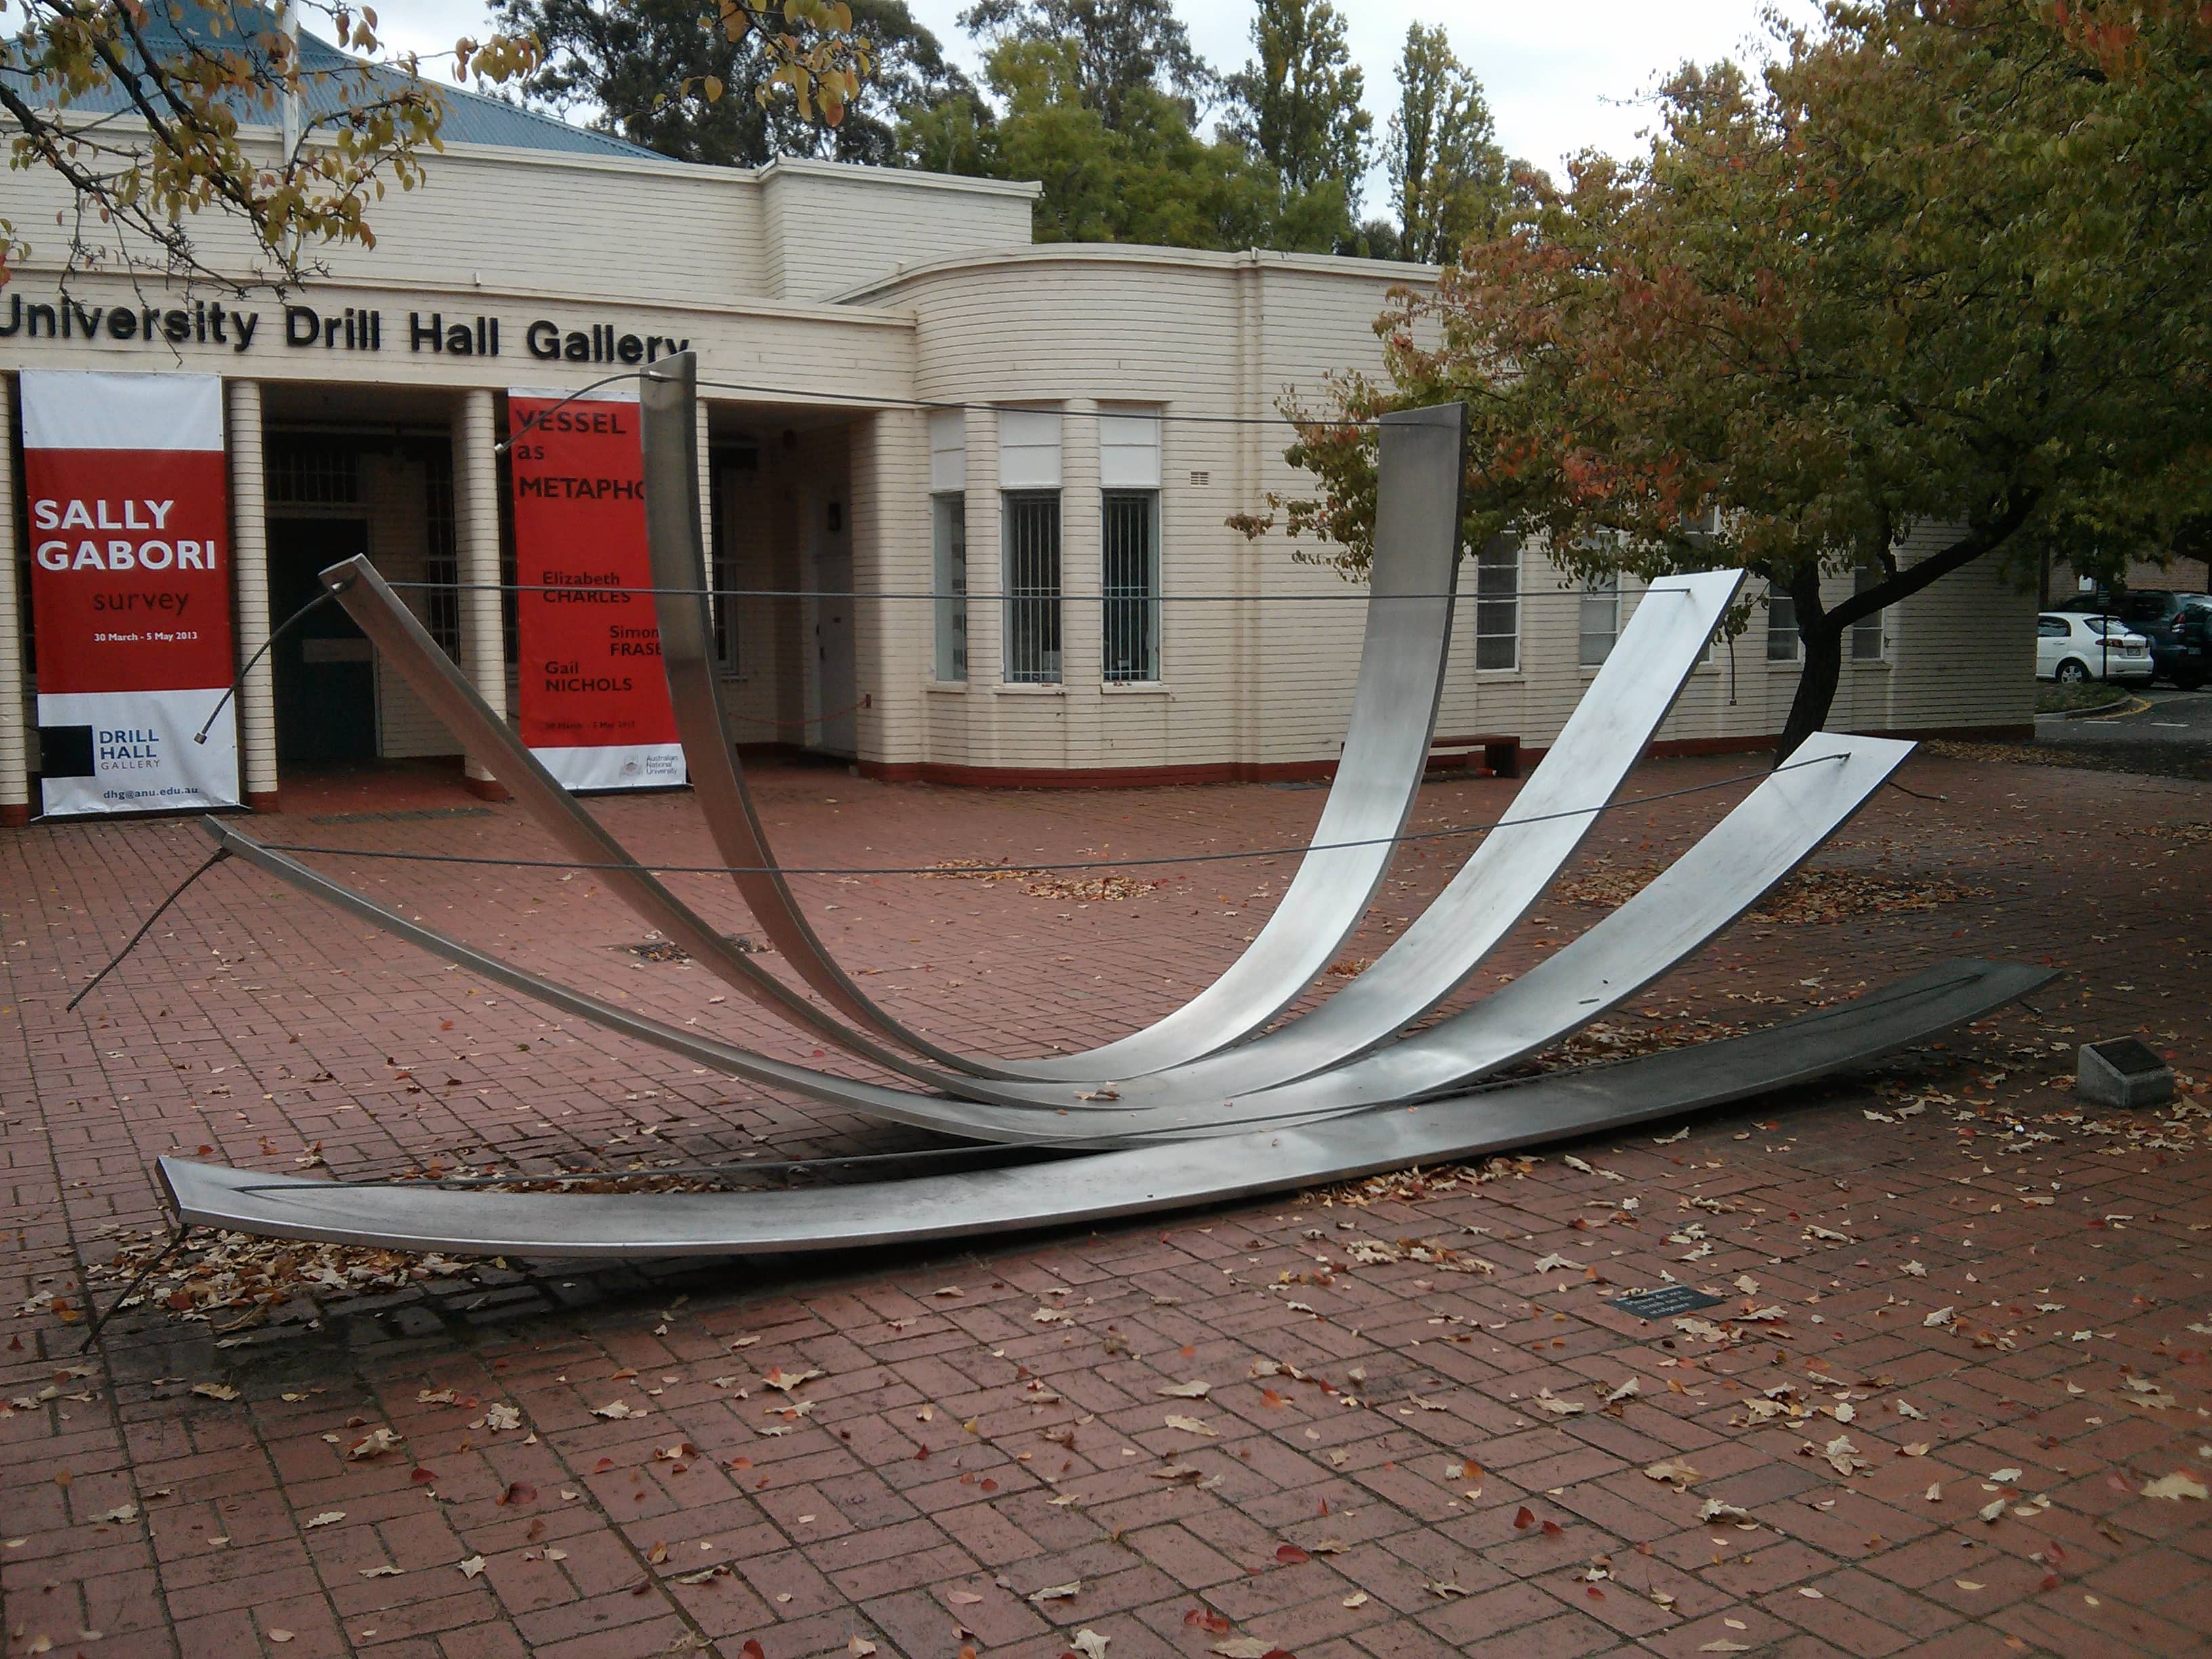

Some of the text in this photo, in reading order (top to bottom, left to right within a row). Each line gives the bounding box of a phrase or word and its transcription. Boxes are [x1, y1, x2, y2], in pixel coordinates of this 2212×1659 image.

[285, 304, 381, 351] Drill
[409, 311, 499, 357] Hall
[516, 409, 627, 434] VESSEL
[517, 444, 545, 461] as
[35, 499, 174, 530] SALLY
[37, 539, 216, 571] GABORI
[543, 571, 620, 586] Elizabeth
[543, 588, 631, 603] CHARLES
[94, 592, 189, 616] survey
[94, 633, 106, 642] 30
[108, 632, 138, 642] March
[146, 632, 152, 640] 5
[155, 632, 173, 642] May
[175, 631, 198, 640] 2013
[609, 625, 659, 638] Simon
[545, 661, 579, 674] Gail
[546, 678, 633, 692] NICHOLS
[99, 729, 159, 744] DRILL
[100, 745, 157, 760] HALL
[101, 759, 161, 770] GALLERY
[646, 767, 678, 775] University
[103, 786, 199, 800] dhg@anu.edu.au
